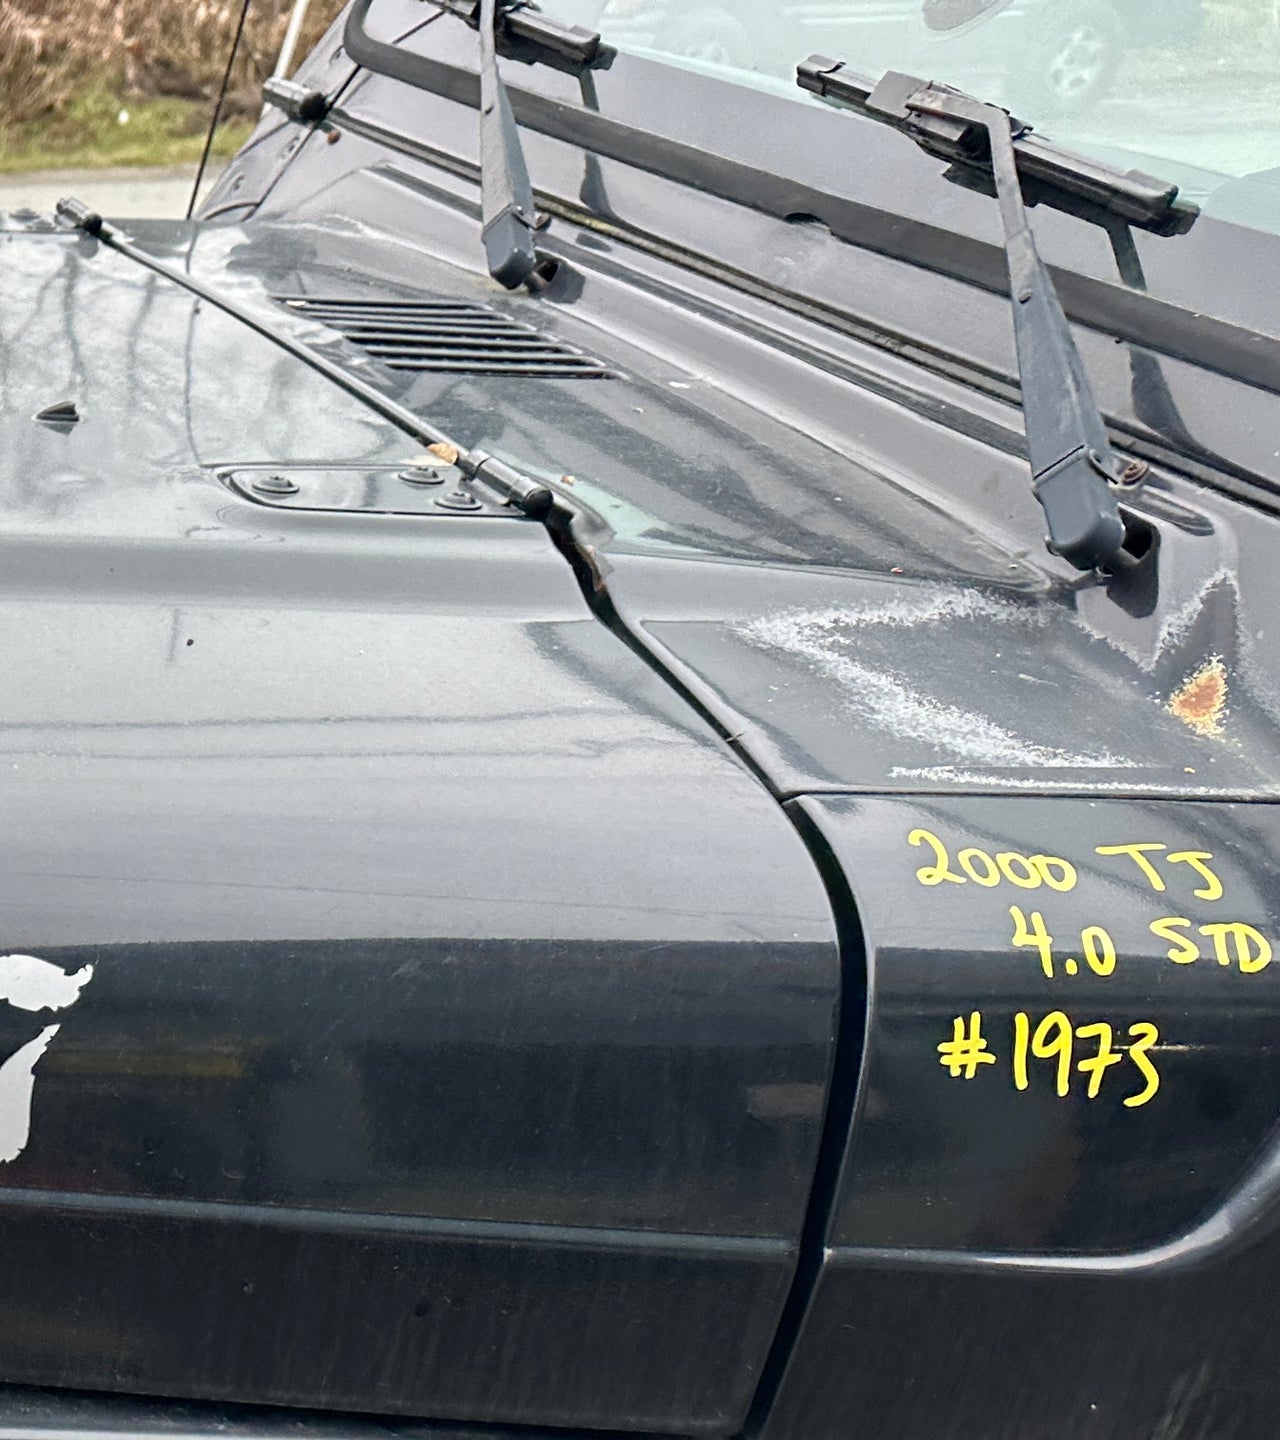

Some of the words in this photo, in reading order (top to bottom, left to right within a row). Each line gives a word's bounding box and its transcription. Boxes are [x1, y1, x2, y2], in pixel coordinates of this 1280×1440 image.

[908, 829, 1078, 891] 2000
[1095, 843, 1222, 900] TJ
[1009, 905, 1117, 978] 4.0
[1149, 917, 1272, 974] STD
[937, 1010, 1161, 1108] #1973
